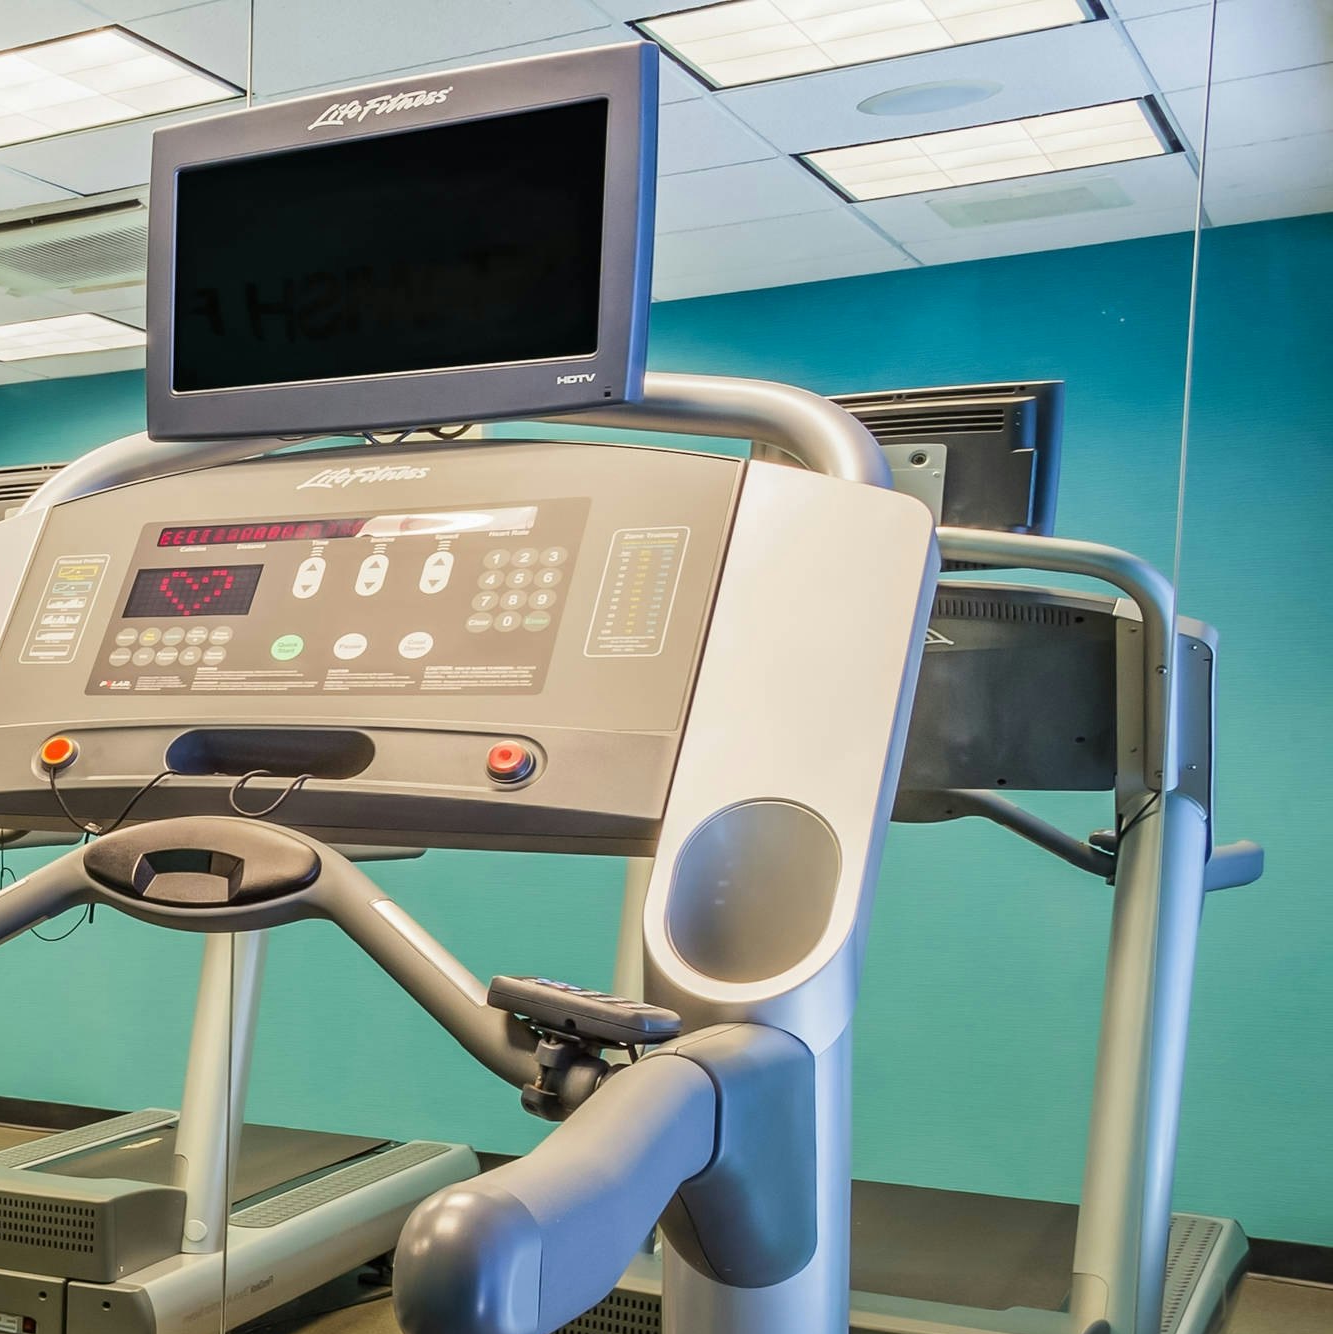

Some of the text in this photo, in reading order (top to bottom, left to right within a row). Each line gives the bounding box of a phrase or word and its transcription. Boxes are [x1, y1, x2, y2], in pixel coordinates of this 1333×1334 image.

[556, 373, 597, 385] HDTV
[492, 552, 559, 564] 1 2 3
[485, 572, 553, 585] 4 5 6
[481, 594, 547, 607] 7 8 9
[502, 616, 512, 626] 0
